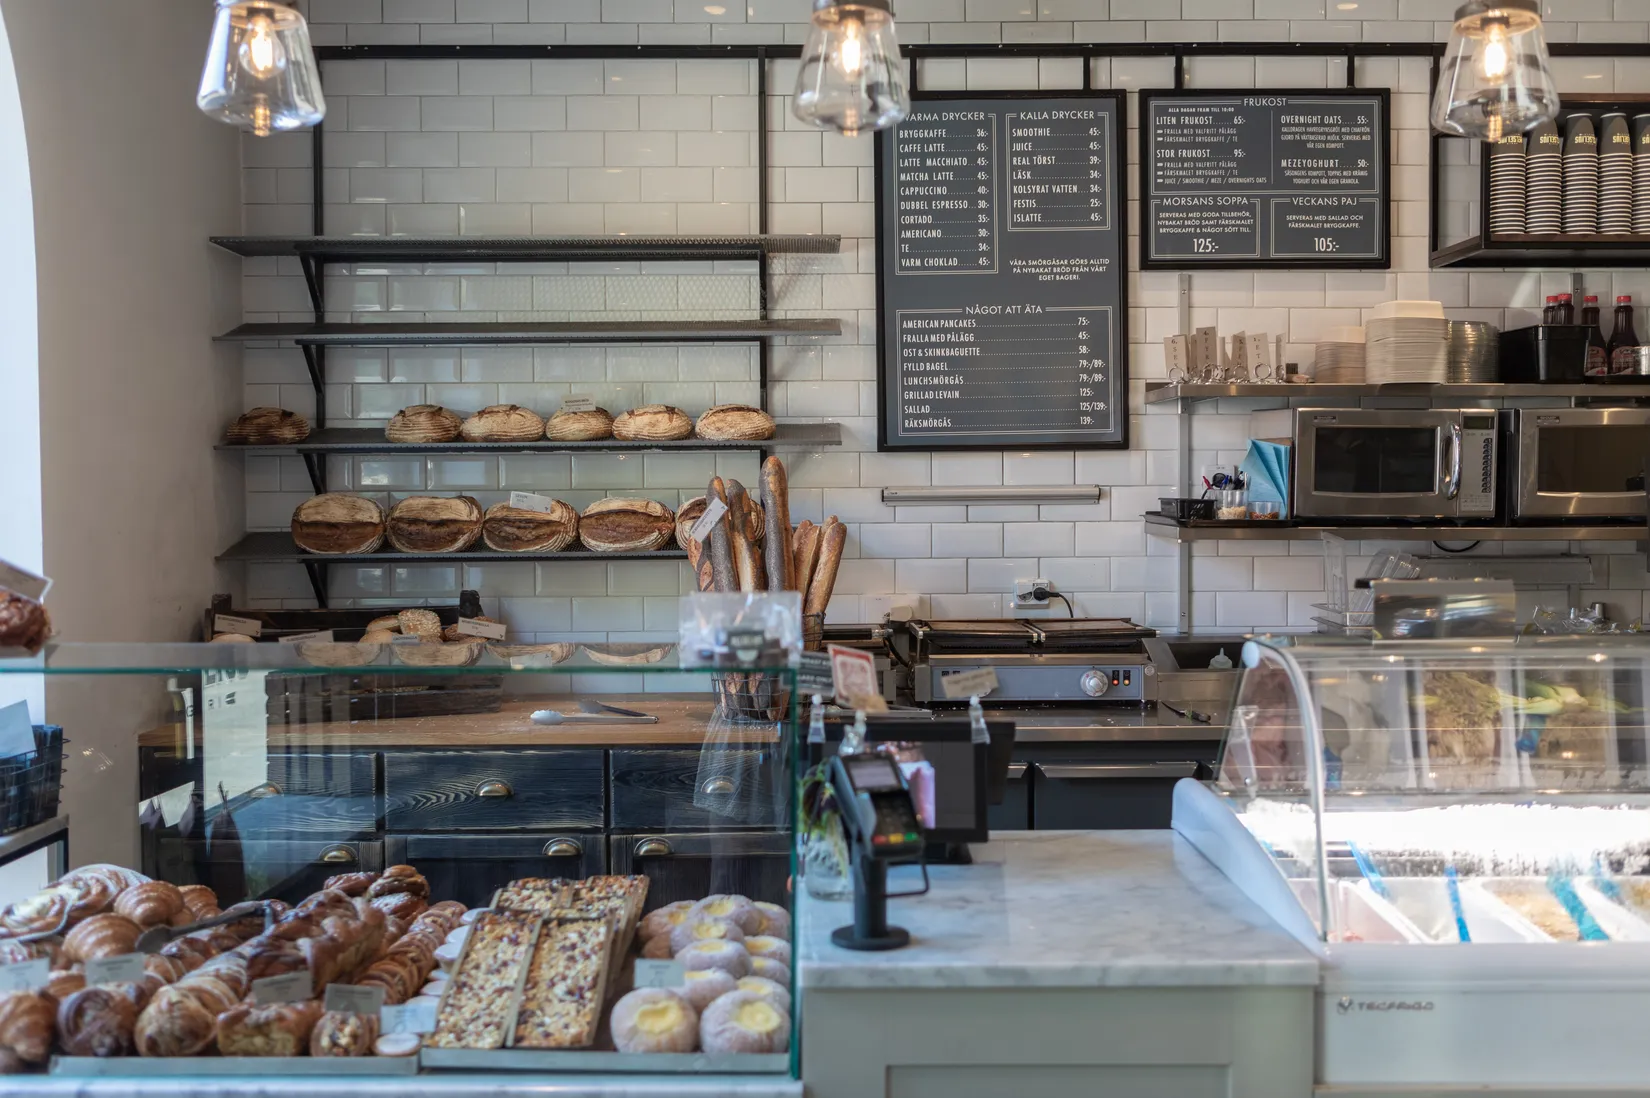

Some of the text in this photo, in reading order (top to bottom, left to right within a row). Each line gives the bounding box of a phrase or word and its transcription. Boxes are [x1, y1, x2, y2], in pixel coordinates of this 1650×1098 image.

[1244, 98, 1286, 106] FRUKOST
[905, 111, 984, 121] VARMA DRYCKER
[1021, 111, 1094, 120] KALLA DRYCKER
[1181, 116, 1212, 124] FRUKOST
[1234, 116, 1245, 124] 65:-
[1324, 116, 1341, 124] OATS
[1357, 116, 1368, 124] 55:-
[900, 129, 988, 138] BRYGGKAFFE 36:-
[1013, 128, 1050, 136] SMOOTHIE
[900, 143, 988, 152] CAFFE LATTE 45:-
[1013, 142, 1101, 151] JUICE 45:-
[1157, 149, 1245, 158] STOR FRUKOST 95:-
[900, 157, 988, 167] LATTE MACCHIATO 45:-
[1013, 155, 1101, 165] REAL TÖRST 39:-
[1281, 159, 1369, 167] MEZEYOGHURT 50:-
[900, 172, 989, 181] MATCHA LATTE 45:-
[1013, 170, 1101, 179] LÄSK 34:-
[901, 186, 989, 195] CAPPUCCINO 40:-
[1014, 185, 1049, 193] KOLSYRAT
[1052, 185, 1077, 193] VATTEN
[901, 200, 989, 209] DUBBEL ESPRESSO 30:-
[1014, 199, 1102, 208] FESTIS 25:-
[1163, 197, 1248, 205] MORSANS SOPPA
[1292, 197, 1356, 205] VECKANS PAJ
[901, 216, 933, 224] CORTADO
[901, 229, 990, 238] AMERICANO 30:-
[901, 243, 990, 252] TE 34:-
[1193, 239, 1218, 252] 125:-
[1315, 238, 1339, 251] 105:-
[925, 258, 957, 266] CHOKLAD
[979, 257, 990, 265] 45:-
[1070, 258, 1088, 266] GÖRS
[966, 304, 1042, 314] NÅGOT ATT ÄTA
[903, 317, 1089, 328] AMERICAN PANCAKES 75:-
[903, 331, 1090, 342] FRALLA MED PÅLÄGG 45:-
[924, 348, 980, 356] SKINKBAGUETTE
[904, 359, 1105, 371] FYLLD BAGEL 79:-/89:-
[904, 373, 1106, 385] LUNCHSMÖRGÅS 79:-/89:-
[904, 388, 1094, 399] GRILLAD LEVAIN 125:-
[905, 402, 1107, 413] SALLAD 125/139:-
[905, 417, 951, 427] RÄKSMÖRGÅS
